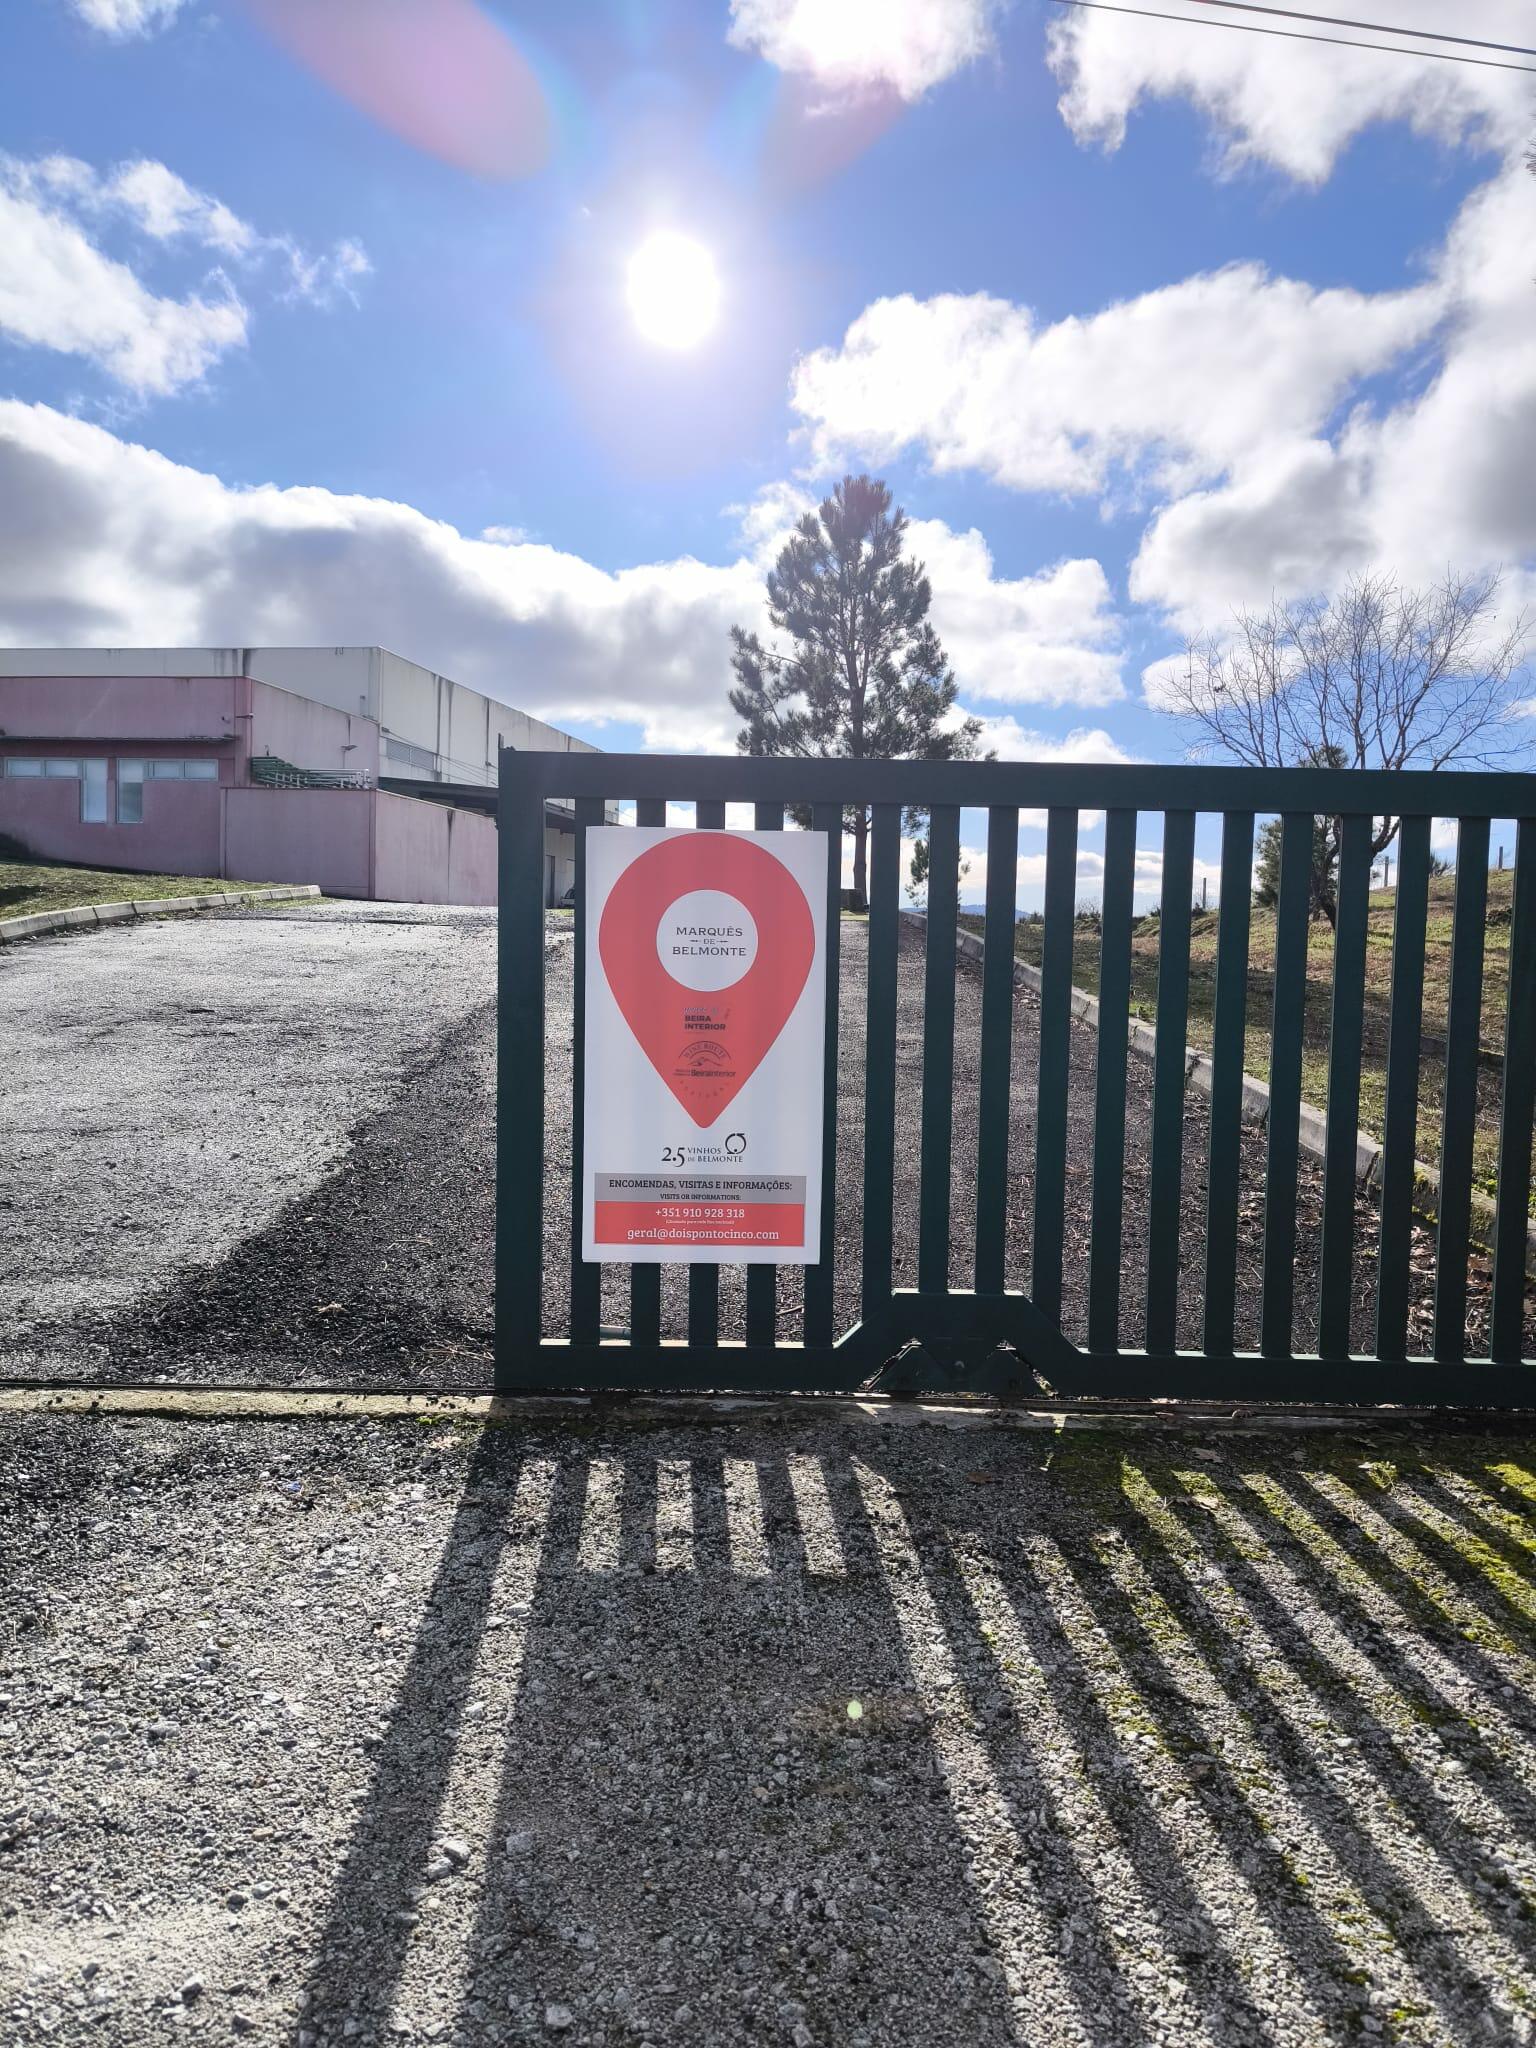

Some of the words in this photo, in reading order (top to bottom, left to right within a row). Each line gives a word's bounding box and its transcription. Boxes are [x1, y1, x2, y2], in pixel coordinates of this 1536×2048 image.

[676, 925, 743, 937] MARQUÊS
[672, 946, 747, 957] BELMONTE
[684, 1023, 726, 1031] INTERIOR
[661, 1147, 685, 1168] 2.5
[697, 1155, 744, 1163] BELMONTE
[609, 1180, 677, 1189] ENCOMENDAS,
[678, 1180, 713, 1189] VISITAS
[715, 1181, 721, 1189] E
[722, 1180, 793, 1192] INFORMAÇÕES:
[656, 1207, 680, 1217] +351
[683, 1208, 702, 1217] 910
[704, 1208, 724, 1218] 928
[726, 1208, 745, 1218] 318
[627, 1227, 780, 1241] geral@doispontocinco.com
